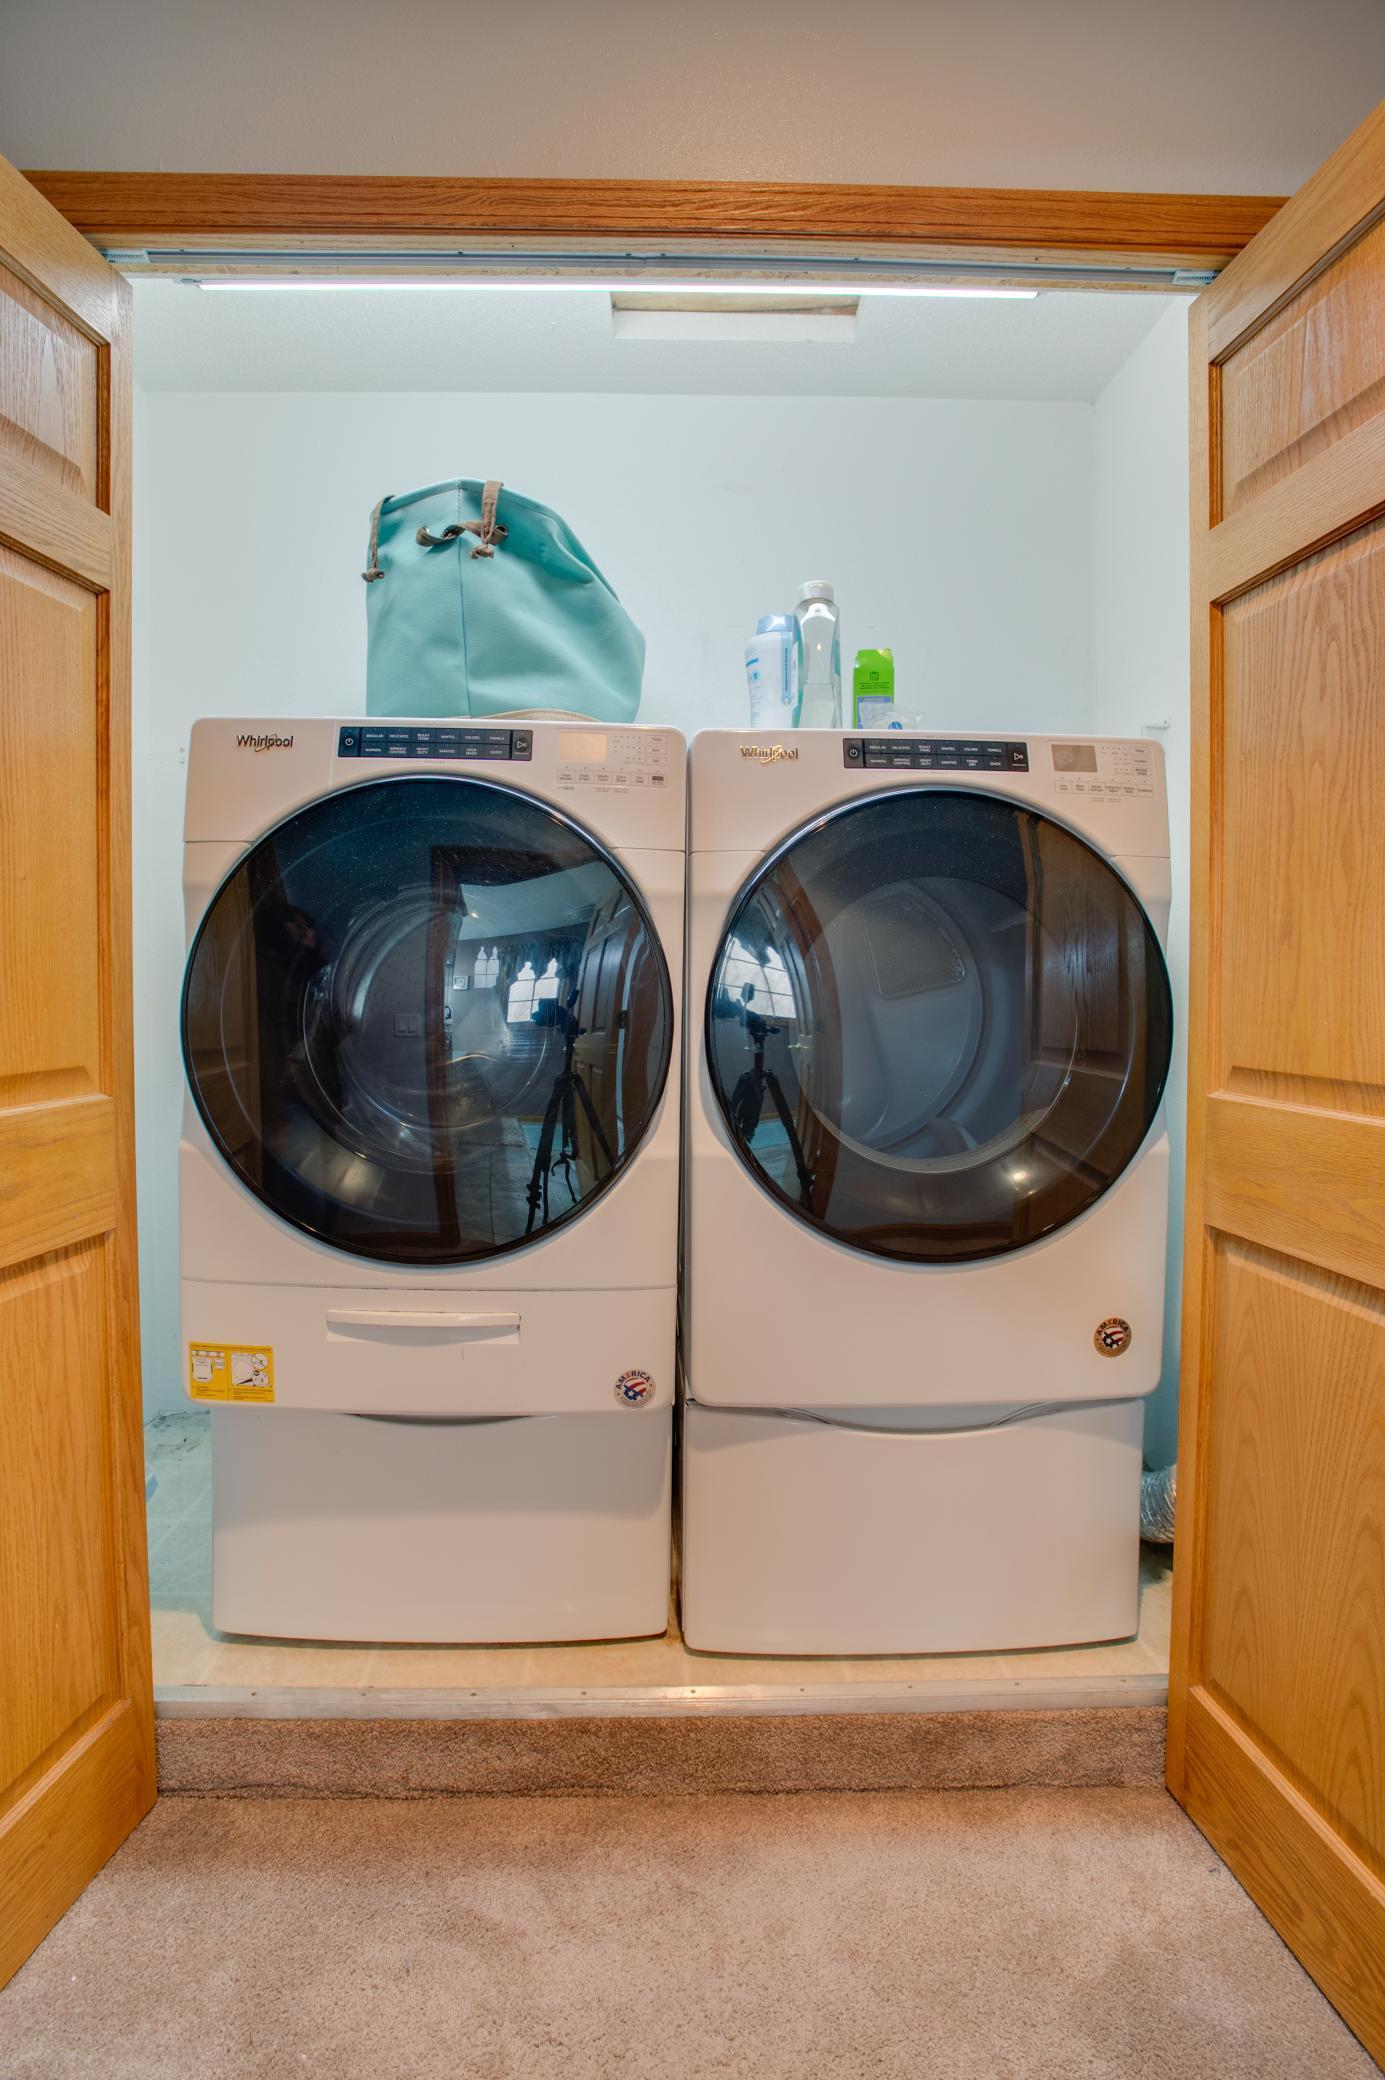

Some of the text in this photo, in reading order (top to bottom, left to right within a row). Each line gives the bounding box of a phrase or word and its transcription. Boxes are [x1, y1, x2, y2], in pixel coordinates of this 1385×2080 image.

[237, 734, 294, 752] Whirlpool
[740, 745, 799, 763] Whirlpool
[1097, 1319, 1129, 1336] AMERICA
[615, 1370, 651, 1390] AMERICA
